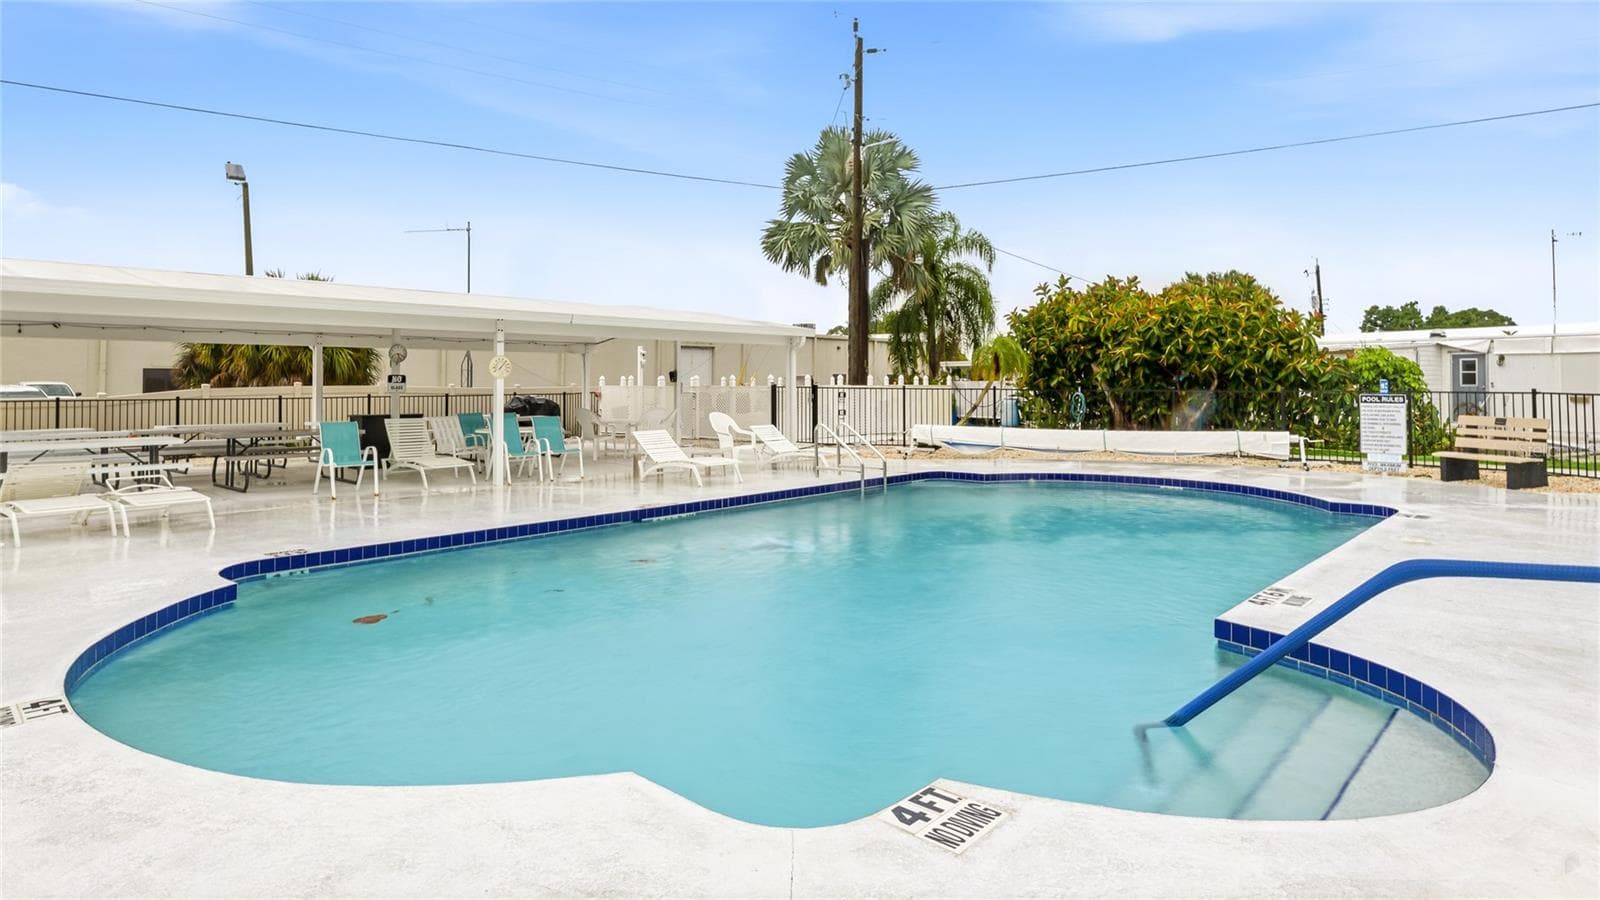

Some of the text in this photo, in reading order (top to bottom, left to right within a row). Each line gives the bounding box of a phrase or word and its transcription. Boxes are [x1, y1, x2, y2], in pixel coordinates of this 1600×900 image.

[22, 699, 62, 710] 4
[891, 787, 963, 826] 4 FT.
[924, 803, 1002, 849] NO DIVING
